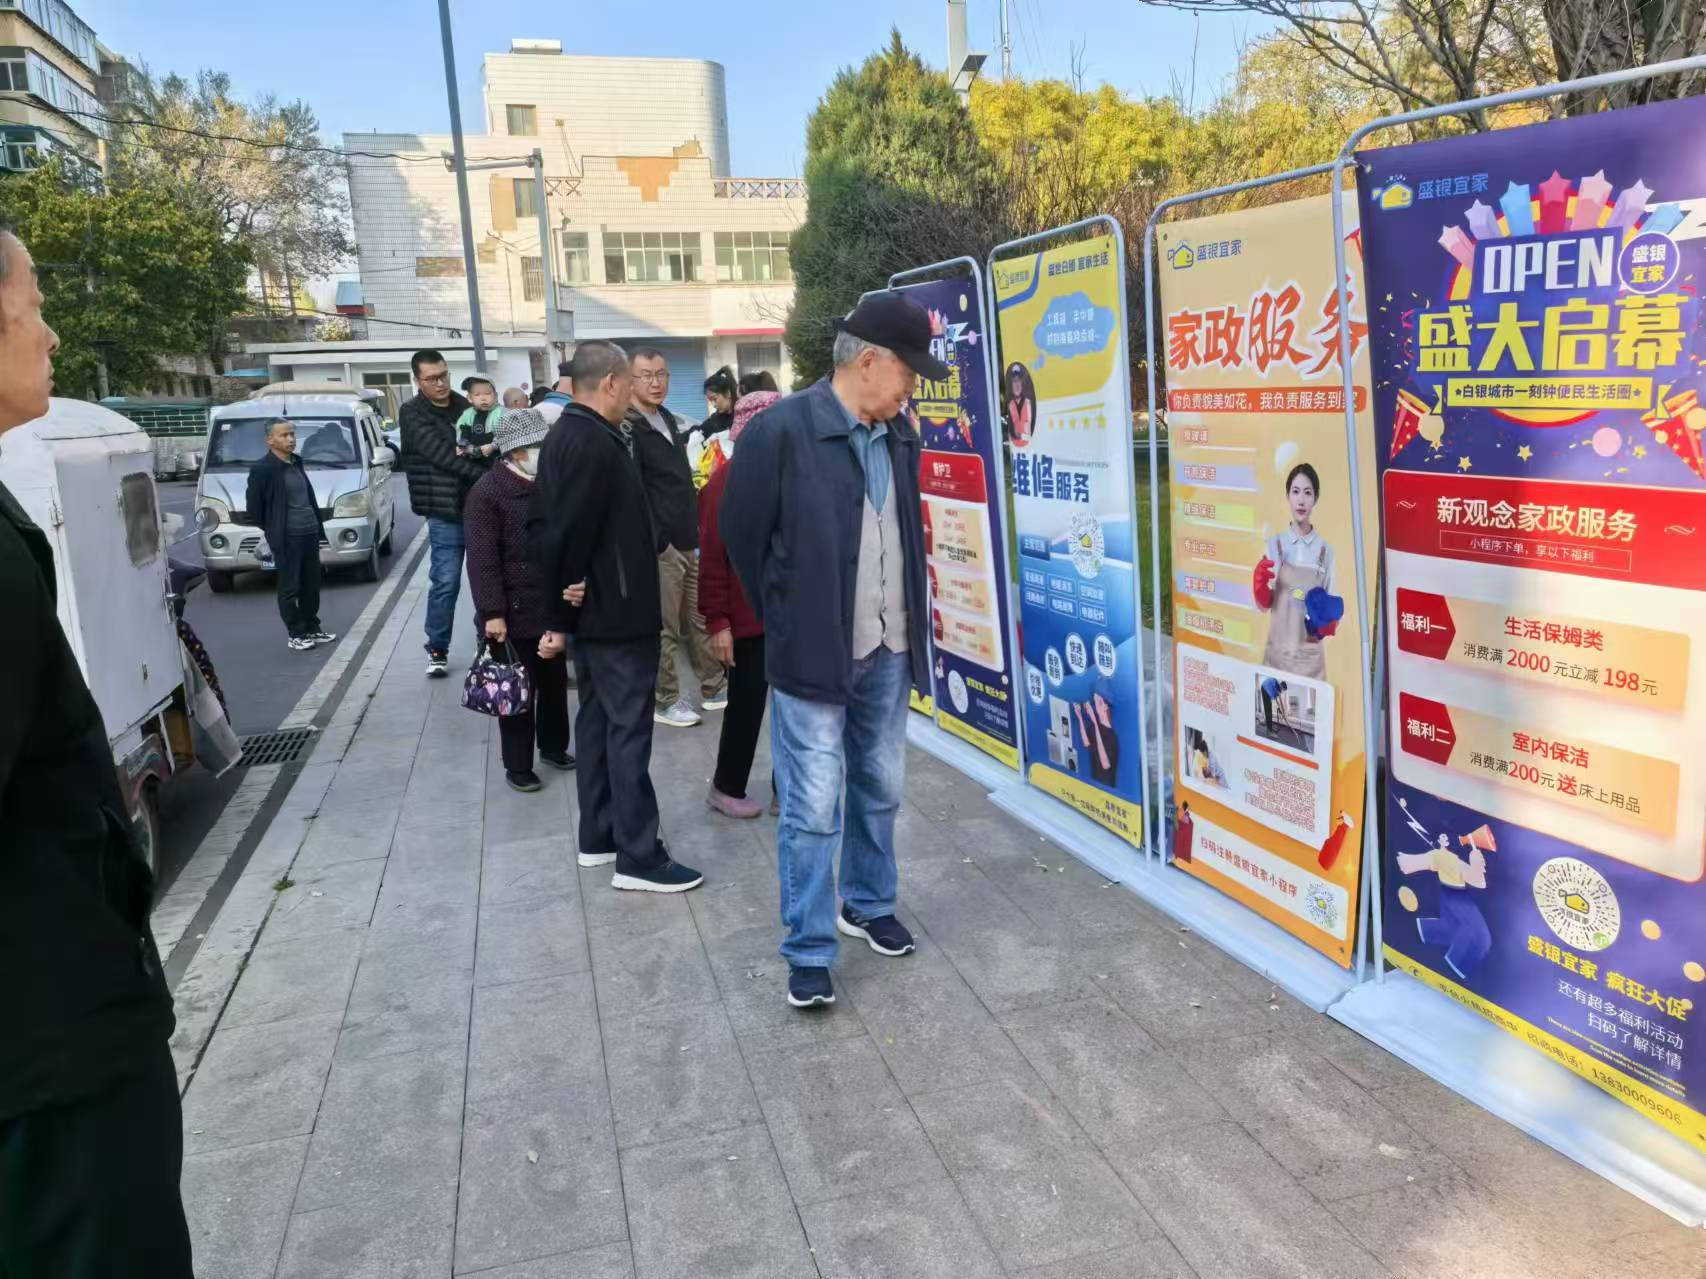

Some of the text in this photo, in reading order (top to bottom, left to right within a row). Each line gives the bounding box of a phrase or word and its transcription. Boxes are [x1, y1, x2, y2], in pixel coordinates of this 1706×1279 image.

[1418, 173, 1488, 200] 盛银宜家
[1482, 235, 1614, 294] OPEN
[1631, 244, 1667, 263] 盛银
[1631, 264, 1665, 283] 宜家
[1167, 272, 1369, 375] 家政服务
[1416, 293, 1688, 372] 盛大启幕
[1461, 383, 1633, 400] 白银城市一刻钟便民生活圈
[1011, 452, 1090, 503] 维修服务
[1436, 496, 1638, 542] 新观念家政服务
[1469, 537, 1594, 563] 小程序下单，享以下福利
[1400, 611, 1447, 634] 福利一
[1503, 616, 1604, 652] 生活保姆类
[1406, 716, 1451, 745] 福利二
[1512, 732, 1590, 769] 室内保洁
[1527, 934, 1598, 981] 盛银宜家
[1558, 979, 1683, 1050] 还有超多福利活动
[1587, 1012, 1682, 1071] 扫码了解详情
